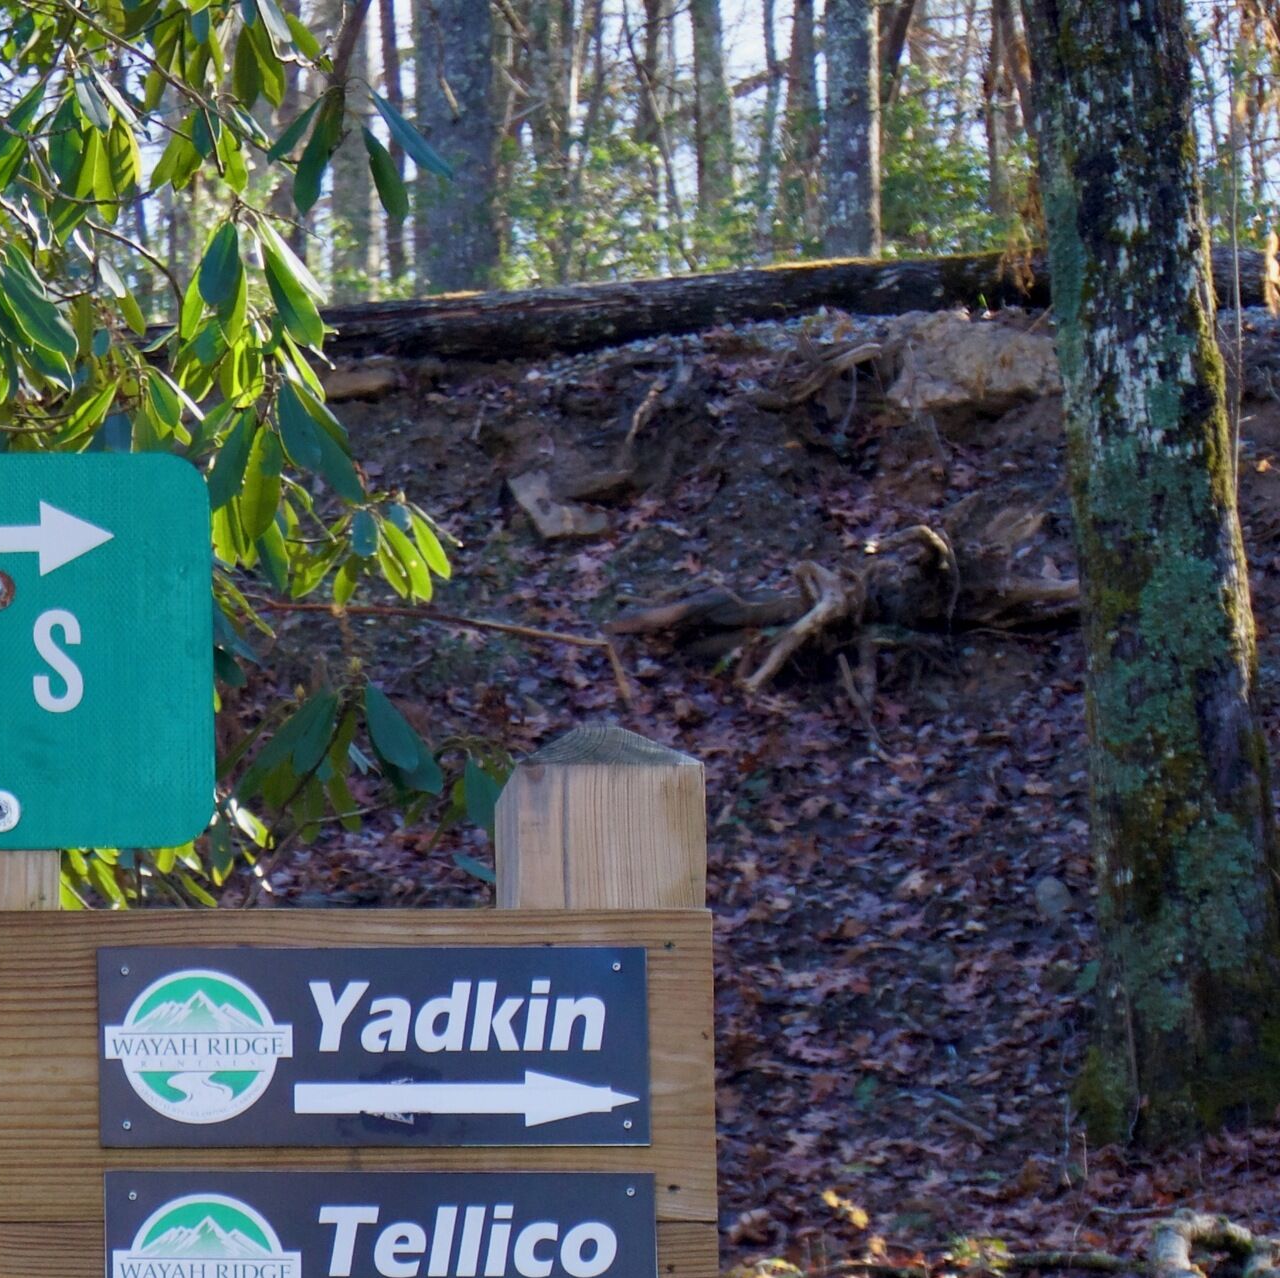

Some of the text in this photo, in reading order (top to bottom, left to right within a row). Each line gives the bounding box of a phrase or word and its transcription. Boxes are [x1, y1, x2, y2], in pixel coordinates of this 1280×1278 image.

[32, 609, 84, 713] S
[112, 1037, 284, 1056] WAYAH RIDGE
[308, 979, 606, 1054] Yadkin
[318, 1205, 618, 1278] Tellico
